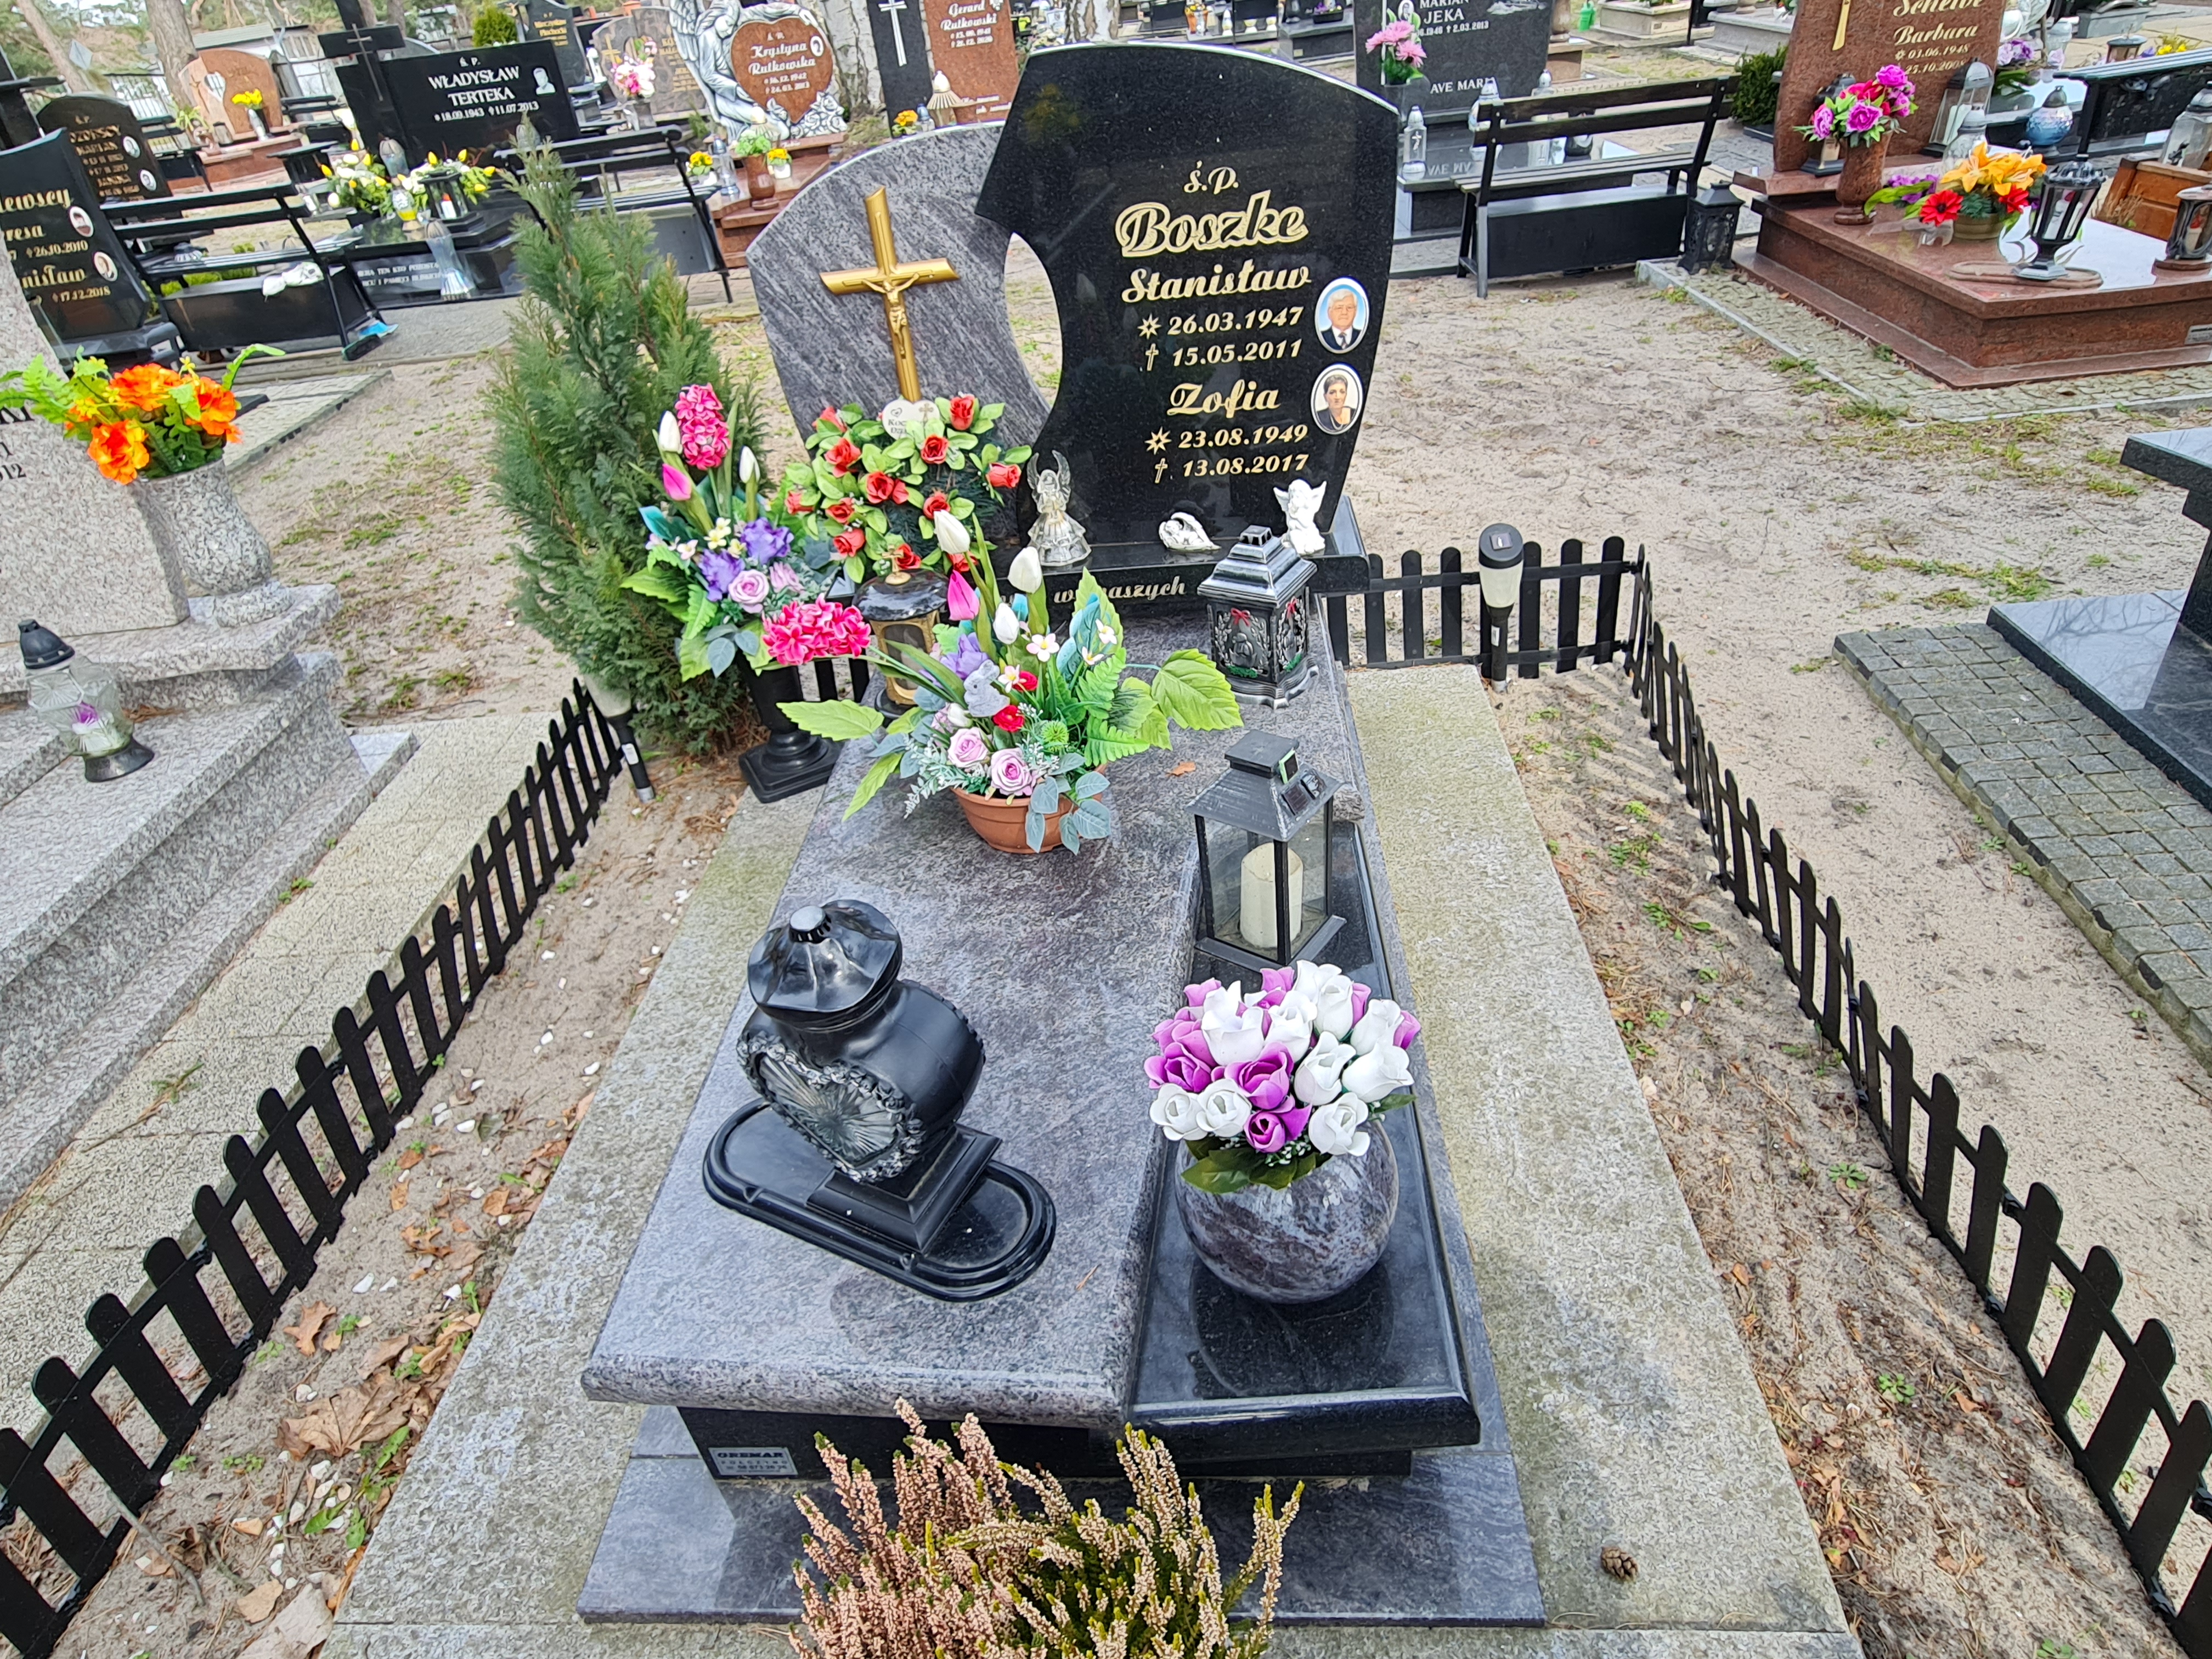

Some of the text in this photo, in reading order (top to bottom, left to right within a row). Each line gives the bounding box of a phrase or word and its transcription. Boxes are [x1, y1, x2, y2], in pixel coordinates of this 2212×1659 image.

[949, 0, 985, 17] Gerard
[1424, 8, 1465, 24] JEKA
[940, 13, 997, 30] Rutkowski
[1453, 20, 1489, 33] 2.03.2013
[1893, 22, 1979, 46] Barbara
[750, 43, 808, 58] Krystyna
[1908, 44, 1969, 60] 03.06.1948
[748, 55, 816, 75] Rutkowska
[428, 66, 520, 89] WŁADYSŁAW
[1430, 77, 1488, 94] AVE MARI
[448, 87, 516, 106] TERTEKA
[441, 100, 539, 122] 18.09.1943 11.07.2013
[0, 189, 72, 213] ewscy
[6, 225, 45, 241] resa
[1115, 189, 1309, 257] Boszke
[34, 240, 89, 258] 26.10.2010
[21, 264, 86, 289] nisław
[1121, 258, 1312, 303] Stanisław
[61, 285, 111, 303] 17.12.2018
[1167, 306, 1304, 336] 26.03.1947
[1172, 338, 1302, 367] 15.05.2011
[1166, 379, 1282, 419] Zofia
[1178, 424, 1308, 449] 23.08.1949
[1182, 454, 1310, 477] 13.08.2017
[1053, 575, 1187, 603] w aszych
